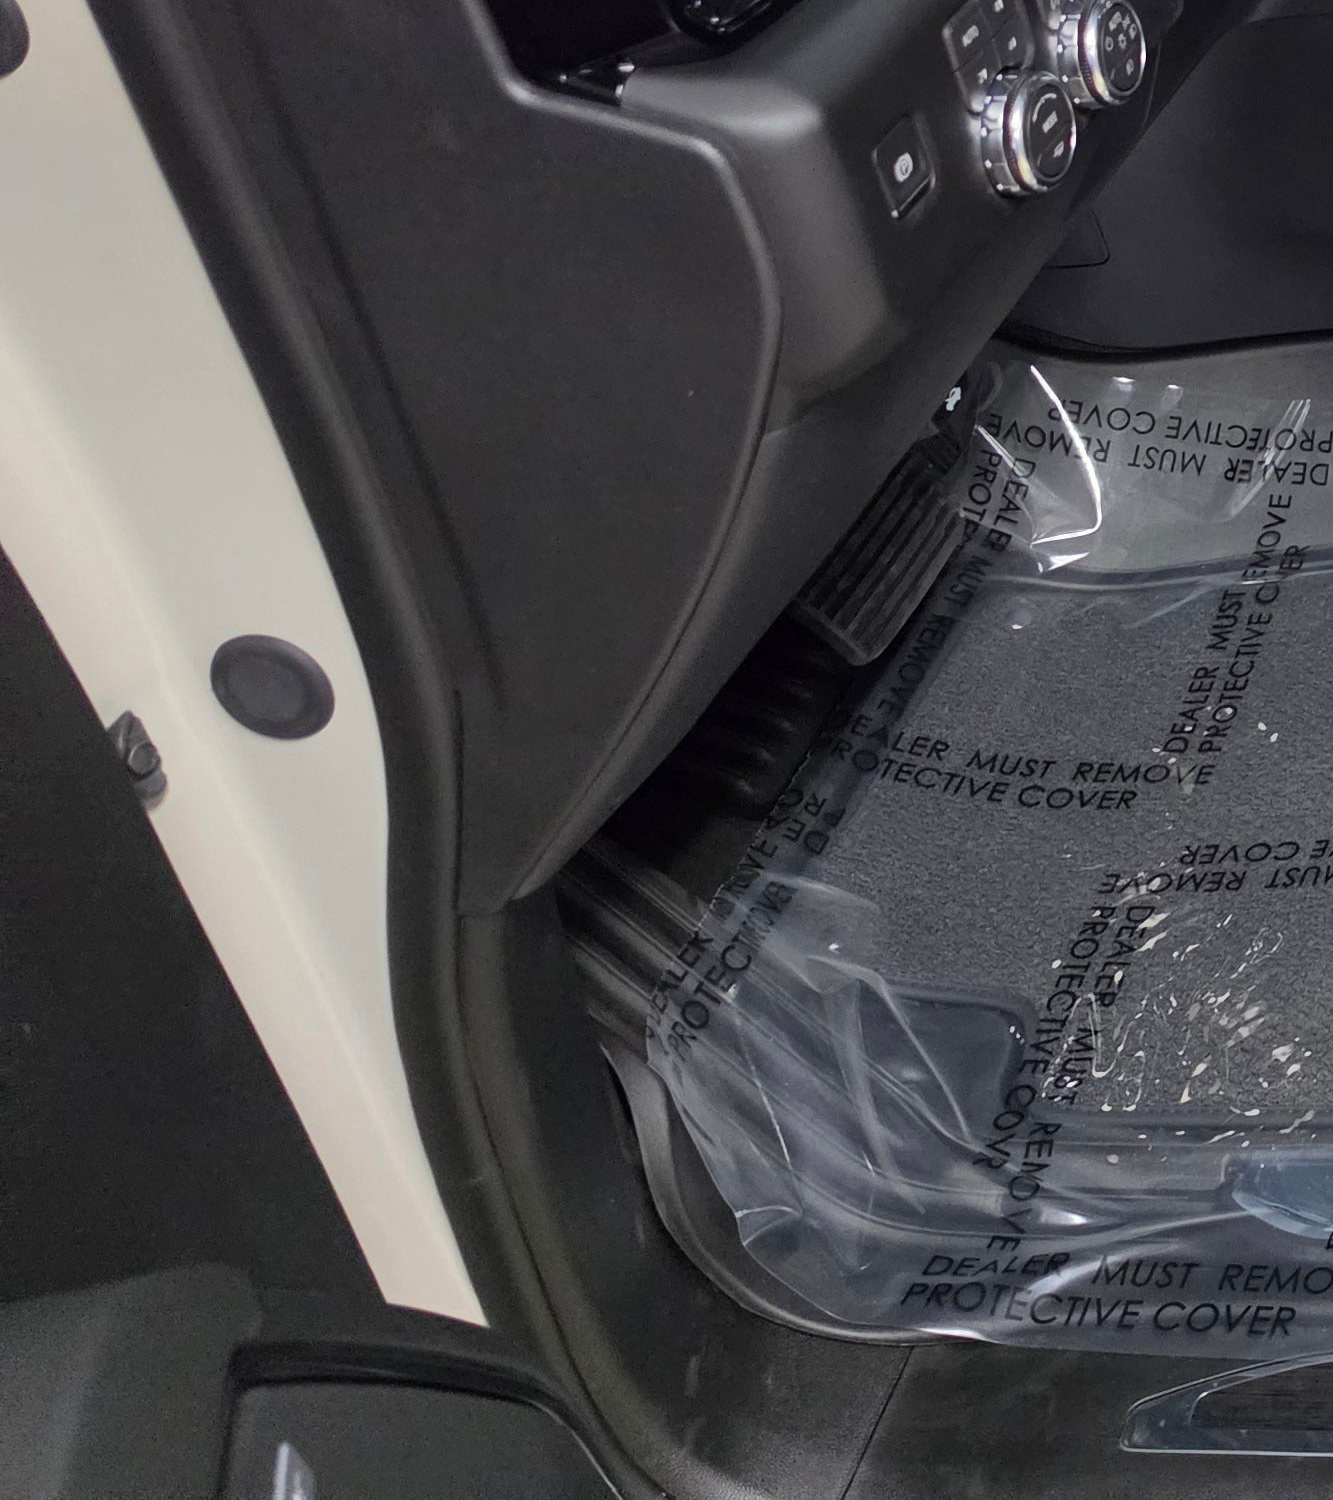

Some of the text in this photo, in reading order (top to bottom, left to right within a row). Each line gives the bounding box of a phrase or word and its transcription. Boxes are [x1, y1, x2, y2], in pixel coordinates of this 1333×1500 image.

[1049, 399, 1333, 454] PROTECTIVE COVER
[1127, 445, 1207, 477] MUST
[1224, 457, 1330, 487] DEALER
[1157, 665, 1218, 754] DEALER
[1205, 587, 1247, 651] MUST
[1200, 611, 1272, 754] PROTECTIVE
[967, 749, 1053, 780] MUST
[1075, 762, 1215, 787] REMOVE
[1018, 784, 1139, 811] COVER
[1180, 840, 1300, 867] COVER
[1097, 870, 1248, 895] REMOVE
[1100, 904, 1157, 1009] DEALER
[1018, 905, 1117, 1077] PROTECTIVE
[921, 1251, 1072, 1279] DEALER
[1090, 1254, 1202, 1289] MUST
[900, 1281, 1298, 1338] PROTECTIVE COVER
